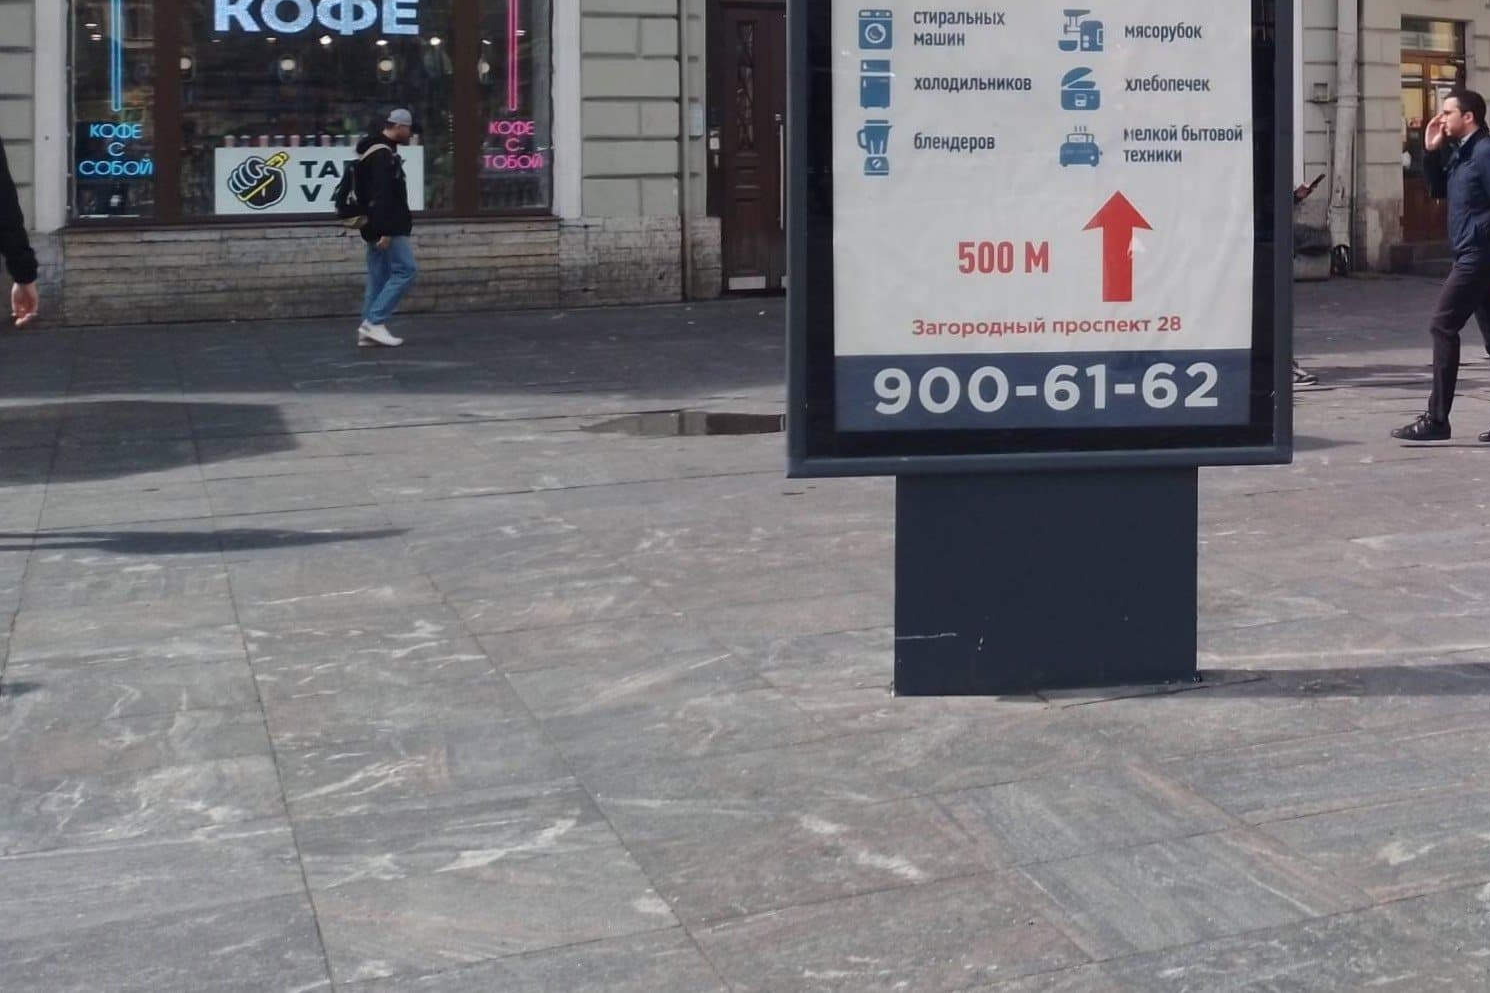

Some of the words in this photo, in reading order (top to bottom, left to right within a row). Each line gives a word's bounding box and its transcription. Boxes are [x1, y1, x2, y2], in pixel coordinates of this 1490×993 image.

[913, 9, 1006, 29] стиральных
[913, 31, 966, 47] машин
[1124, 20, 1203, 42] мясорубок
[914, 74, 1032, 93] холодильников
[1125, 74, 1211, 93] хлебопечек
[89, 123, 143, 139] КОФЕ
[488, 120, 536, 136] КОФЕ
[1123, 125, 1179, 142] мелкой
[1182, 125, 1243, 143] бытовой
[107, 141, 126, 157] С
[505, 137, 521, 152] С
[913, 132, 996, 153] блендеров
[482, 153, 543, 170] ТОБОЙ
[1123, 146, 1183, 164] техники
[79, 157, 153, 176] СОБОЙ
[958, 241, 1014, 274] 500
[911, 317, 1046, 338] Загородный
[1052, 317, 1151, 337] проспект
[1157, 316, 1182, 332] 28
[873, 361, 1219, 414] 900-61-62
